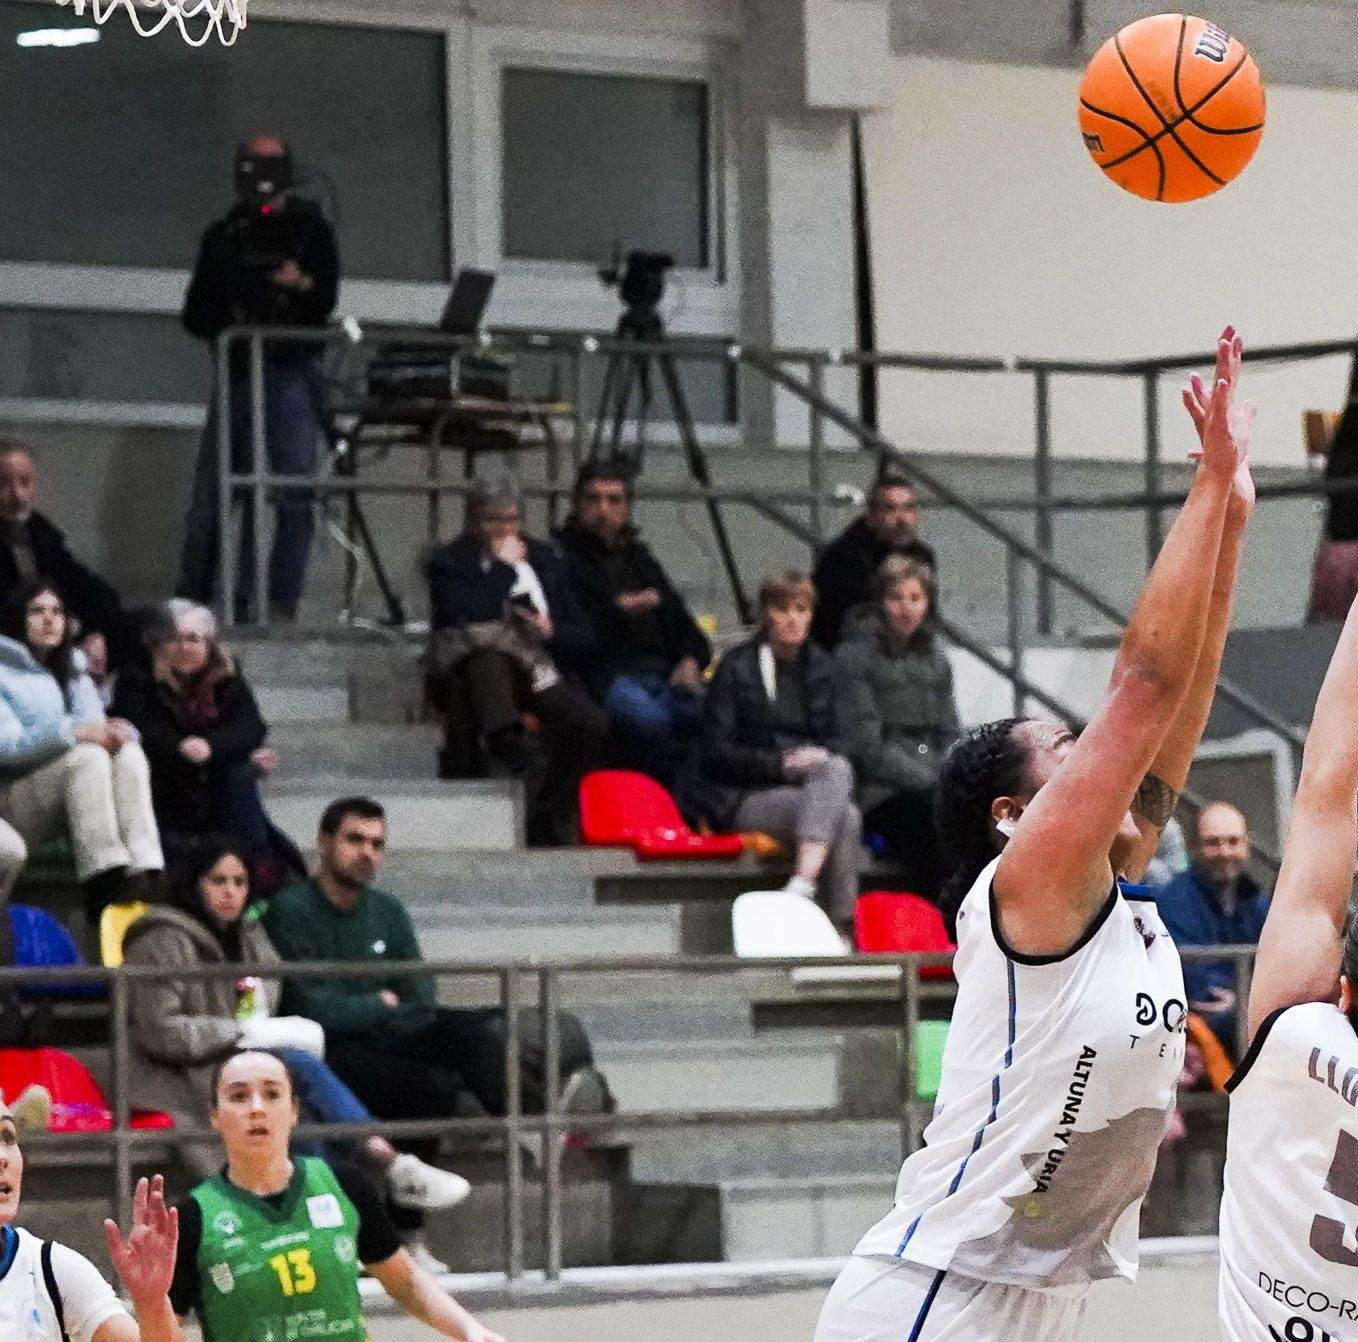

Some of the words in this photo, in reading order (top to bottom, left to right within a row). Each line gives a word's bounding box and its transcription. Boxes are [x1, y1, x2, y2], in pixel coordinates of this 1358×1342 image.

[1059, 1044, 1098, 1126] ALTUNA
[1053, 1131, 1072, 1147] Y
[269, 1249, 317, 1297] 13
